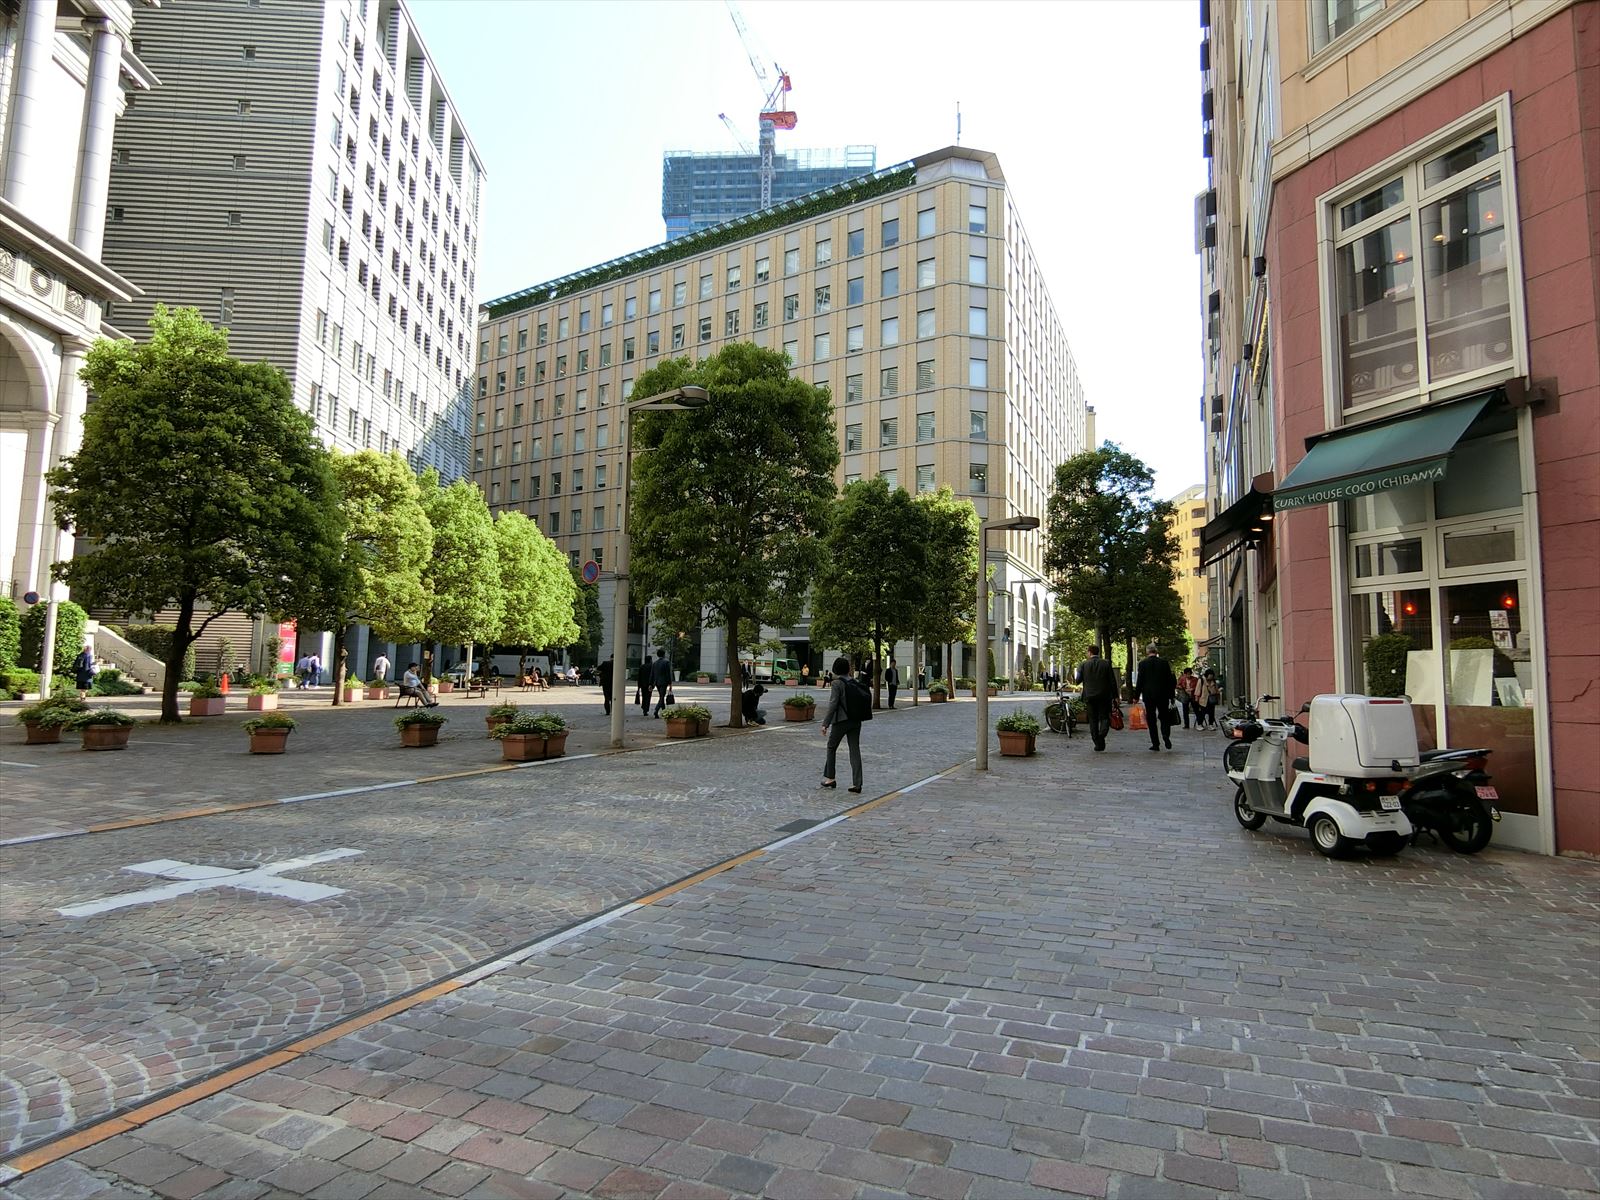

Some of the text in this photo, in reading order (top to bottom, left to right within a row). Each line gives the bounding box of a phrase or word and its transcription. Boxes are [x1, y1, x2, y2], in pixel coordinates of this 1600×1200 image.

[1274, 467, 1444, 509] CURRY HOUSE COCO ICHIBANYA
